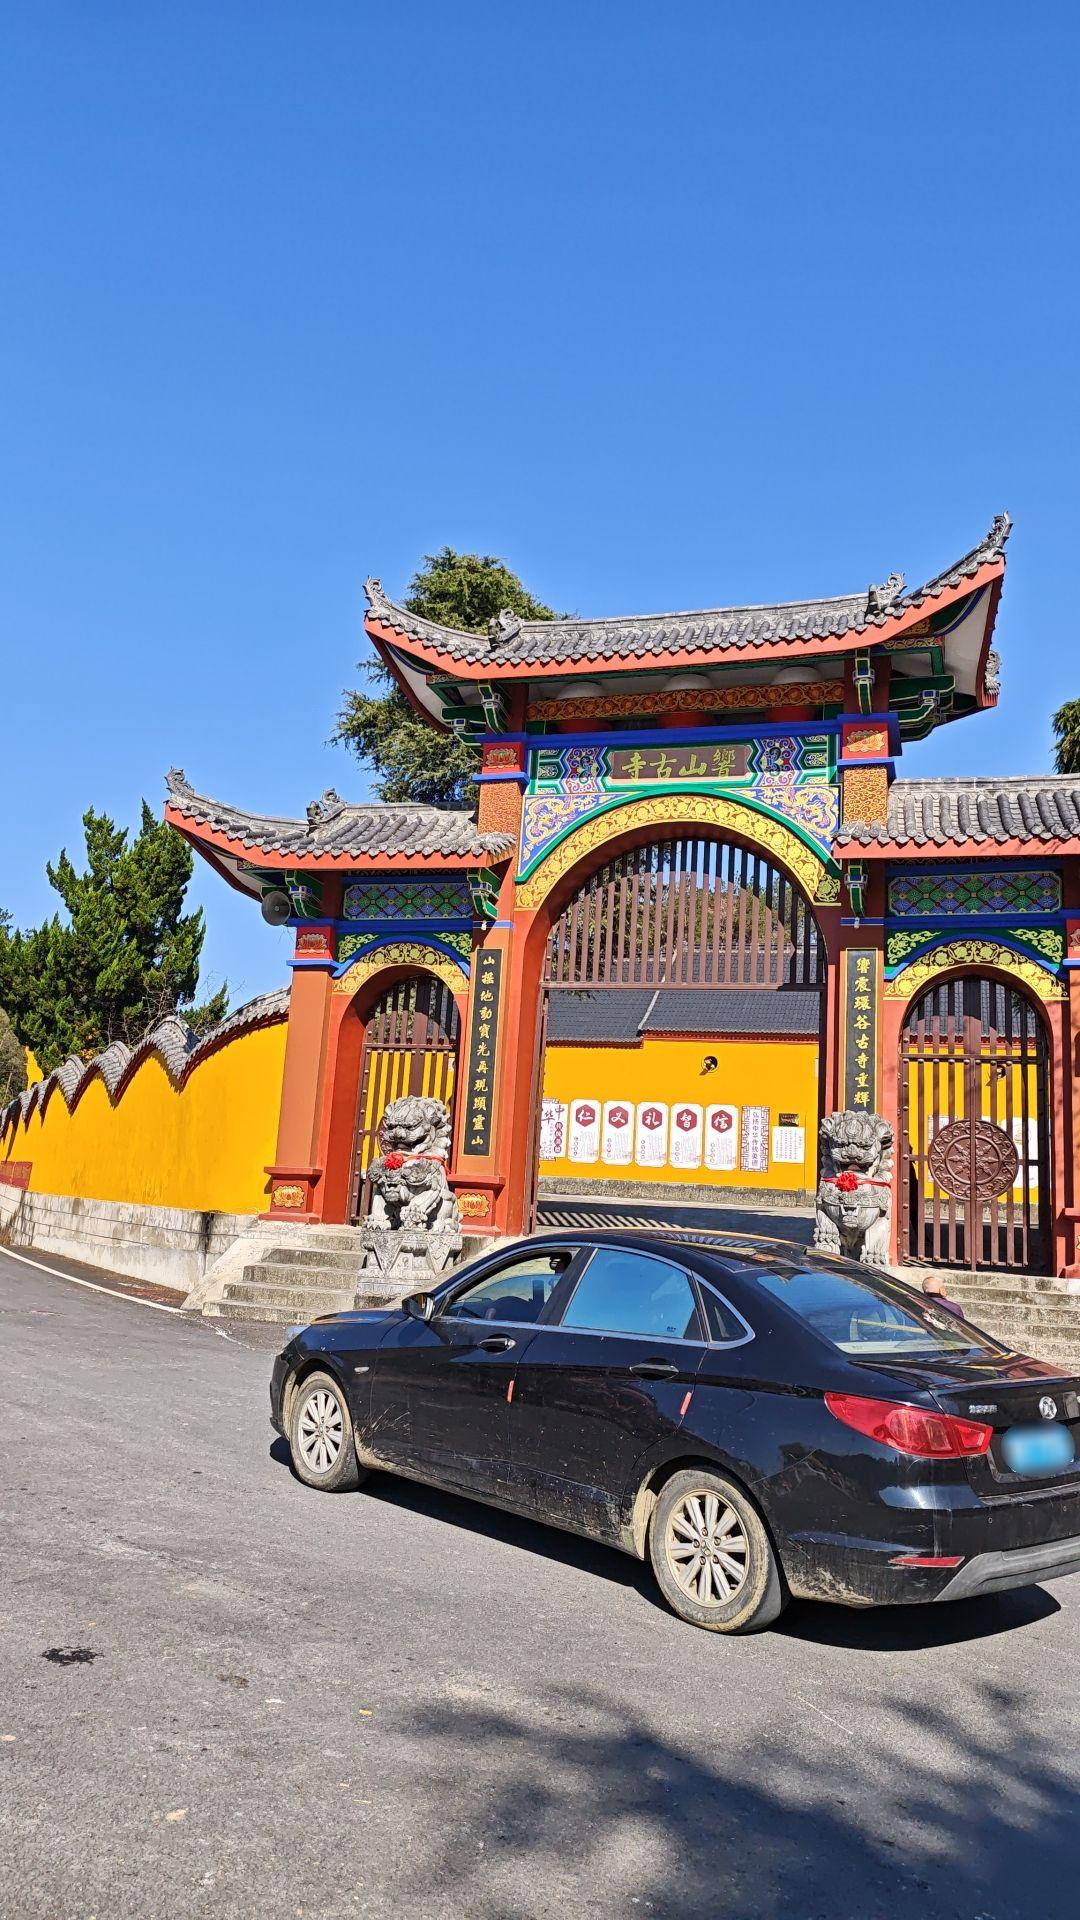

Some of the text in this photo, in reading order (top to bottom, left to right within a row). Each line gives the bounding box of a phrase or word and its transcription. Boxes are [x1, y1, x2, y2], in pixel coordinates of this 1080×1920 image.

[577, 1109, 594, 1122] 仁
[645, 1111, 661, 1126] 礼
[680, 1112, 692, 1128] 智
[713, 1113, 729, 1130] 信
